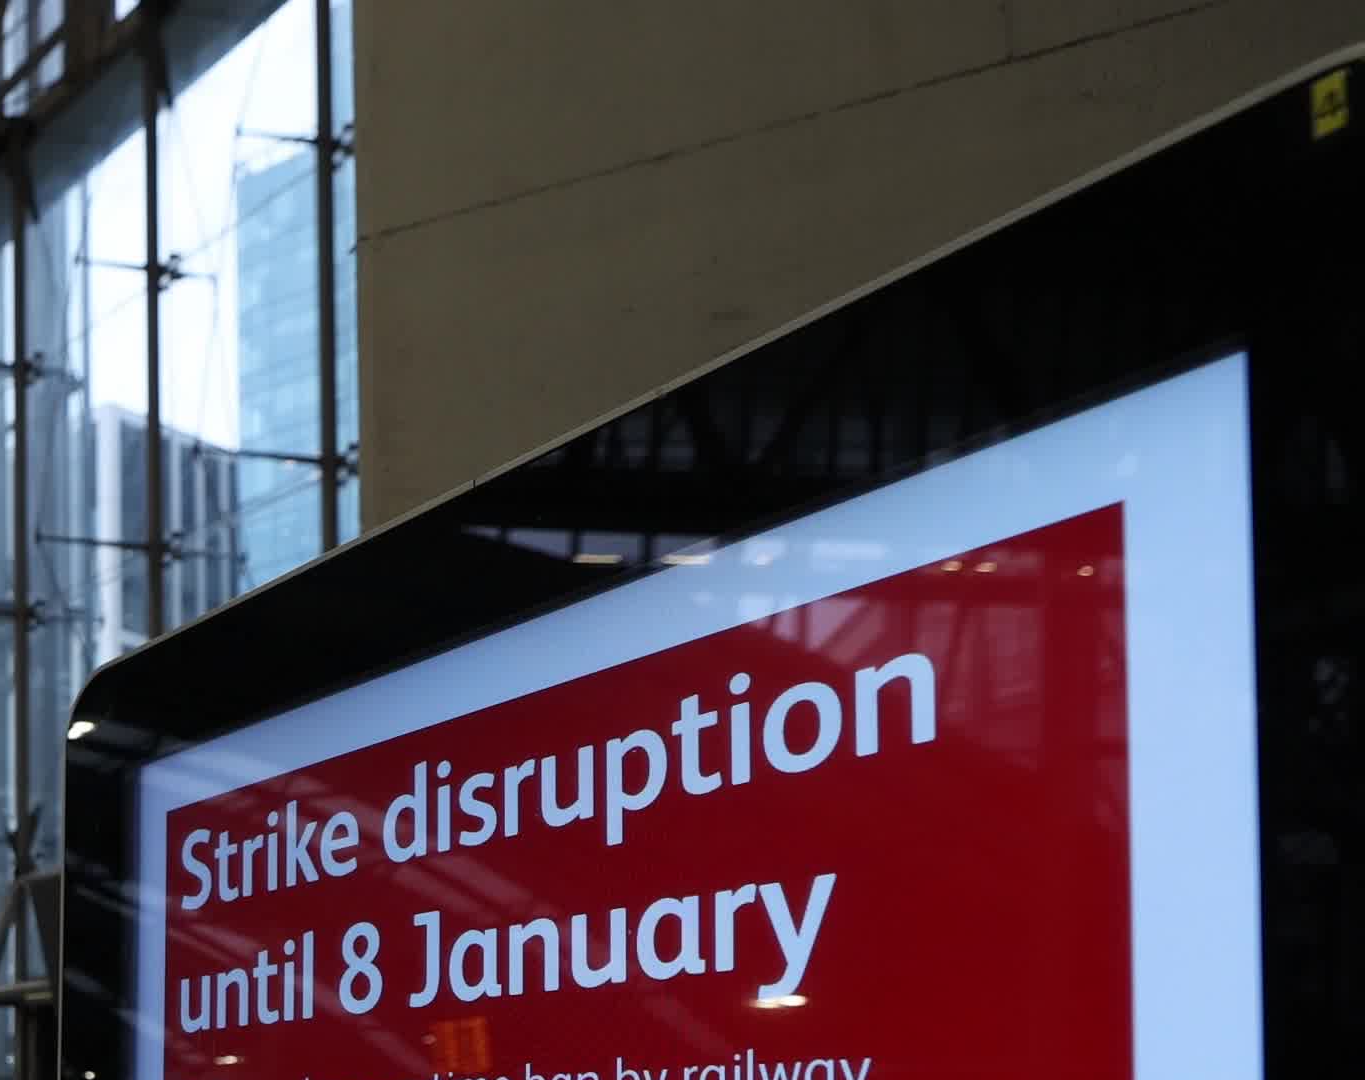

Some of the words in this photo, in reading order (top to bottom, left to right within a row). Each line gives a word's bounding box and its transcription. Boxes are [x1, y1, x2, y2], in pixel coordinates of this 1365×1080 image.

[181, 799, 360, 911] Strike
[382, 652, 936, 863] disruption
[180, 930, 315, 1032] until
[339, 922, 383, 1015] 8
[409, 872, 837, 1008] January
